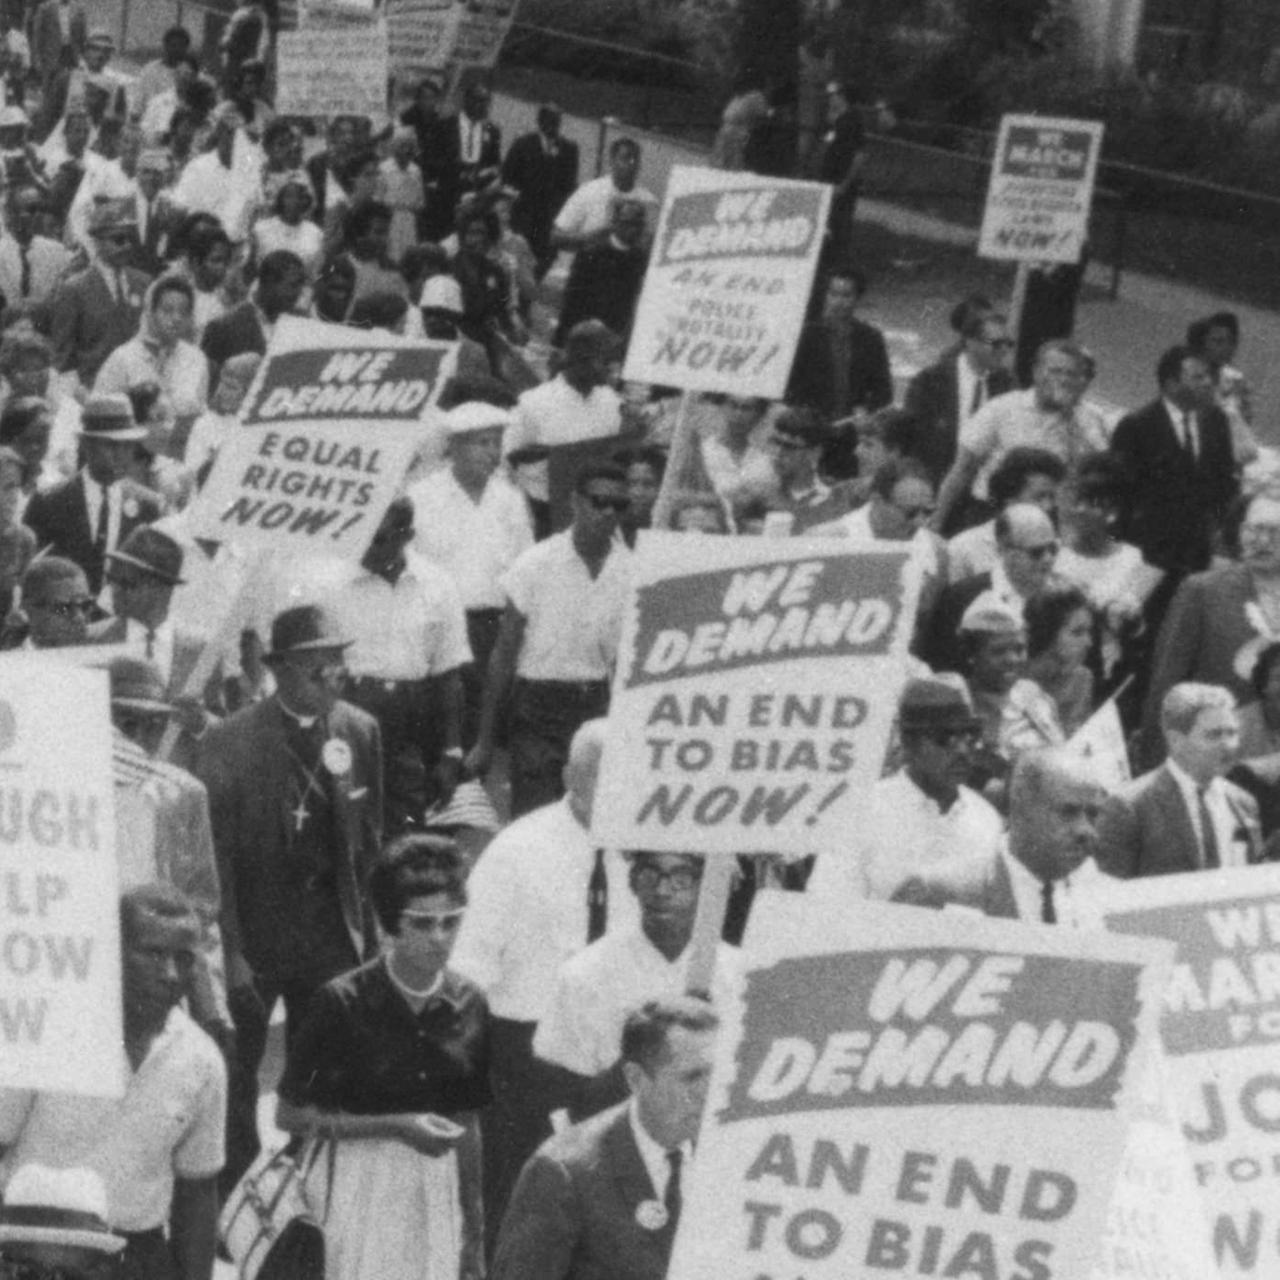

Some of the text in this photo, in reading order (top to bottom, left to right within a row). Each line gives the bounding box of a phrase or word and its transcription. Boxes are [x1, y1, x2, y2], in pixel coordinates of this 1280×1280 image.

[1008, 145, 1086, 169] MARCH
[714, 191, 779, 222] WE
[665, 216, 813, 260] DEMAND
[995, 228, 1074, 254] NOW!
[672, 269, 785, 296] AN END
[319, 351, 397, 383] WE
[651, 336, 781, 376] NOW!
[258, 379, 429, 418] DEMAND
[258, 431, 381, 474] EQUAL
[241, 464, 376, 507] RIGHTS
[219, 495, 366, 540] NOW!
[721, 560, 825, 616] WE
[643, 597, 893, 675] DEMAND
[646, 693, 870, 730] AN END
[645, 738, 856, 773] TO BIAS
[635, 780, 848, 827] NOW!
[867, 954, 1025, 1022] WE
[1158, 951, 1280, 1013] MAR
[1227, 1010, 1280, 1043] FO
[746, 1020, 1122, 1102] DEMAND
[1181, 1072, 1280, 1145] JO
[743, 1132, 871, 1196] AN
[895, 1149, 1080, 1224] END
[1193, 1152, 1280, 1188] FO
[742, 1200, 846, 1261] TO
